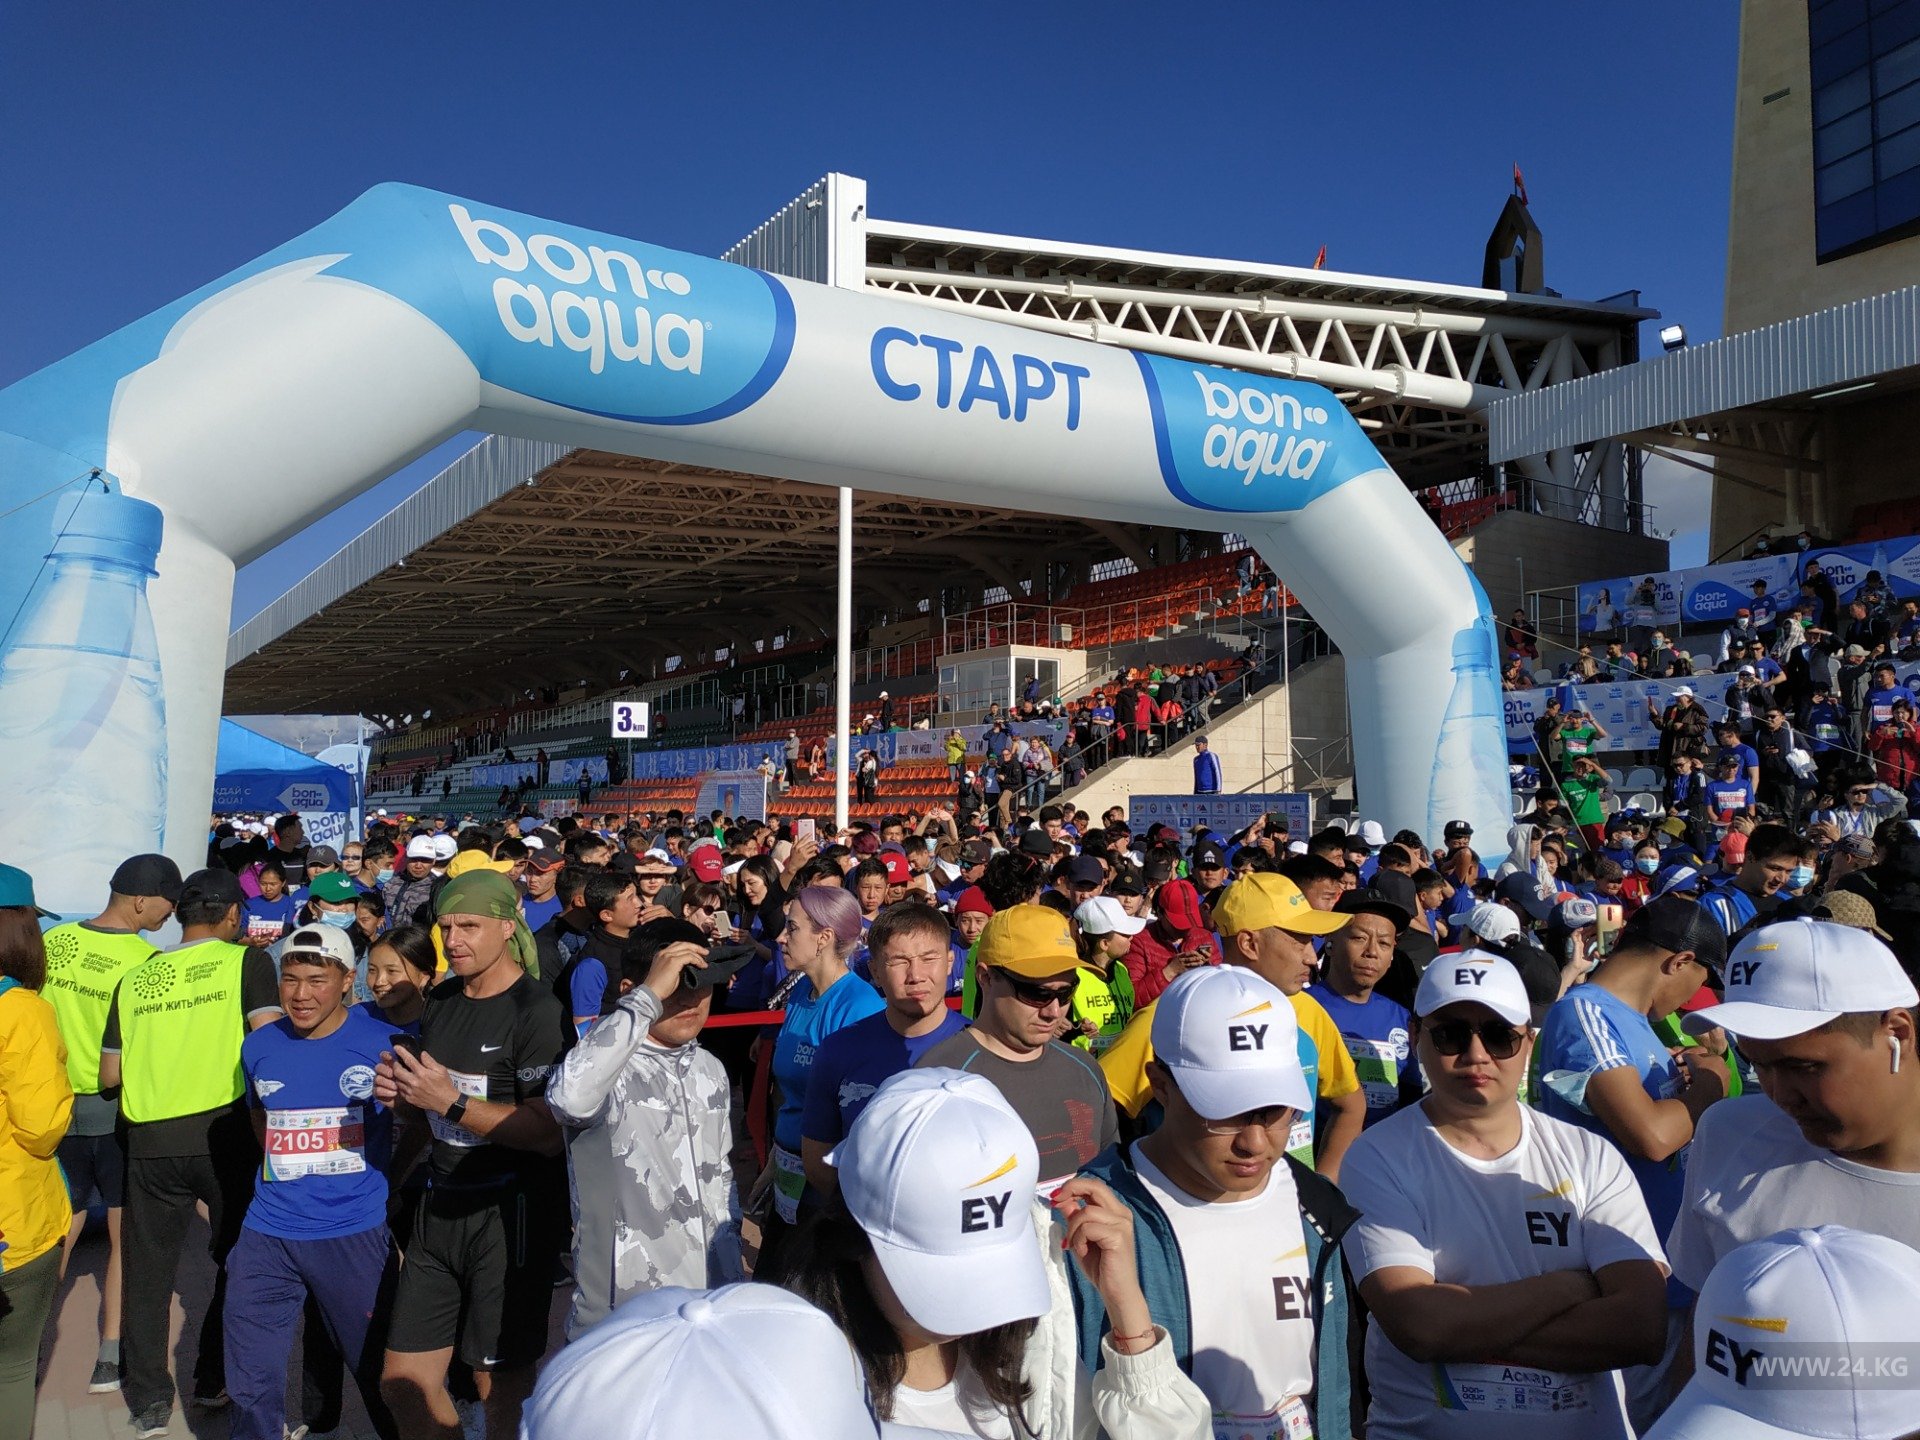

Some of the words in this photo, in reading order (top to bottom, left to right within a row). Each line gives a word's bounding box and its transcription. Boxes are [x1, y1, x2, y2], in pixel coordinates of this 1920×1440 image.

[492, 276, 705, 376] aqua
[869, 326, 1091, 432] СТАРТ
[1202, 424, 1327, 486] aqua
[1694, 599, 1728, 612] aqua
[1503, 700, 1523, 712] on
[617, 706, 633, 733] 3
[632, 723, 646, 733] km
[1504, 712, 1536, 728] qua
[215, 797, 243, 805] QUA!
[292, 798, 323, 809] aqua
[1455, 969, 1488, 986] EY
[1730, 960, 1762, 986] EY
[53, 977, 79, 993] ЖИТЬ
[78, 986, 112, 1002] ИНАЧЕ!
[133, 1003, 163, 1018] НАЧНИ
[165, 998, 193, 1012] ЖИТЬ
[192, 990, 228, 1006] ИНАЧЕ!
[1229, 1024, 1269, 1052] EY
[793, 1054, 814, 1067] aqu
[271, 1131, 325, 1151] 2105
[960, 1191, 1012, 1234] EY
[1524, 1211, 1571, 1247] EY
[1272, 1276, 1314, 1321] EY
[1705, 1327, 1765, 1387] EY
